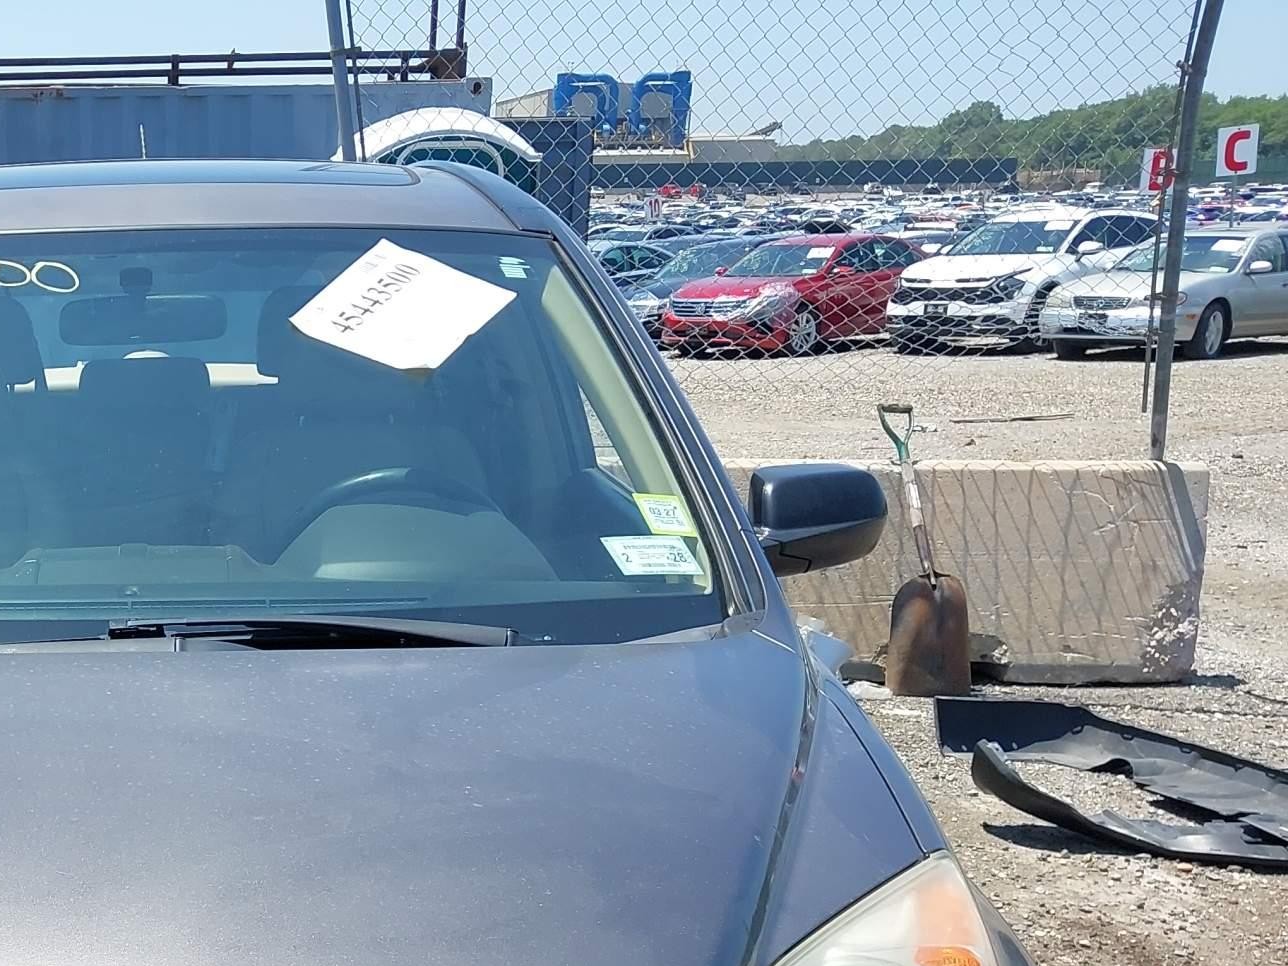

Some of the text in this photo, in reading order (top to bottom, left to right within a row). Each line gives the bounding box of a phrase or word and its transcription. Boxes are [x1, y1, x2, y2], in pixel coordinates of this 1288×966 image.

[1225, 130, 1251, 172] C
[331, 262, 422, 334] 45443500
[621, 552, 633, 563] 2
